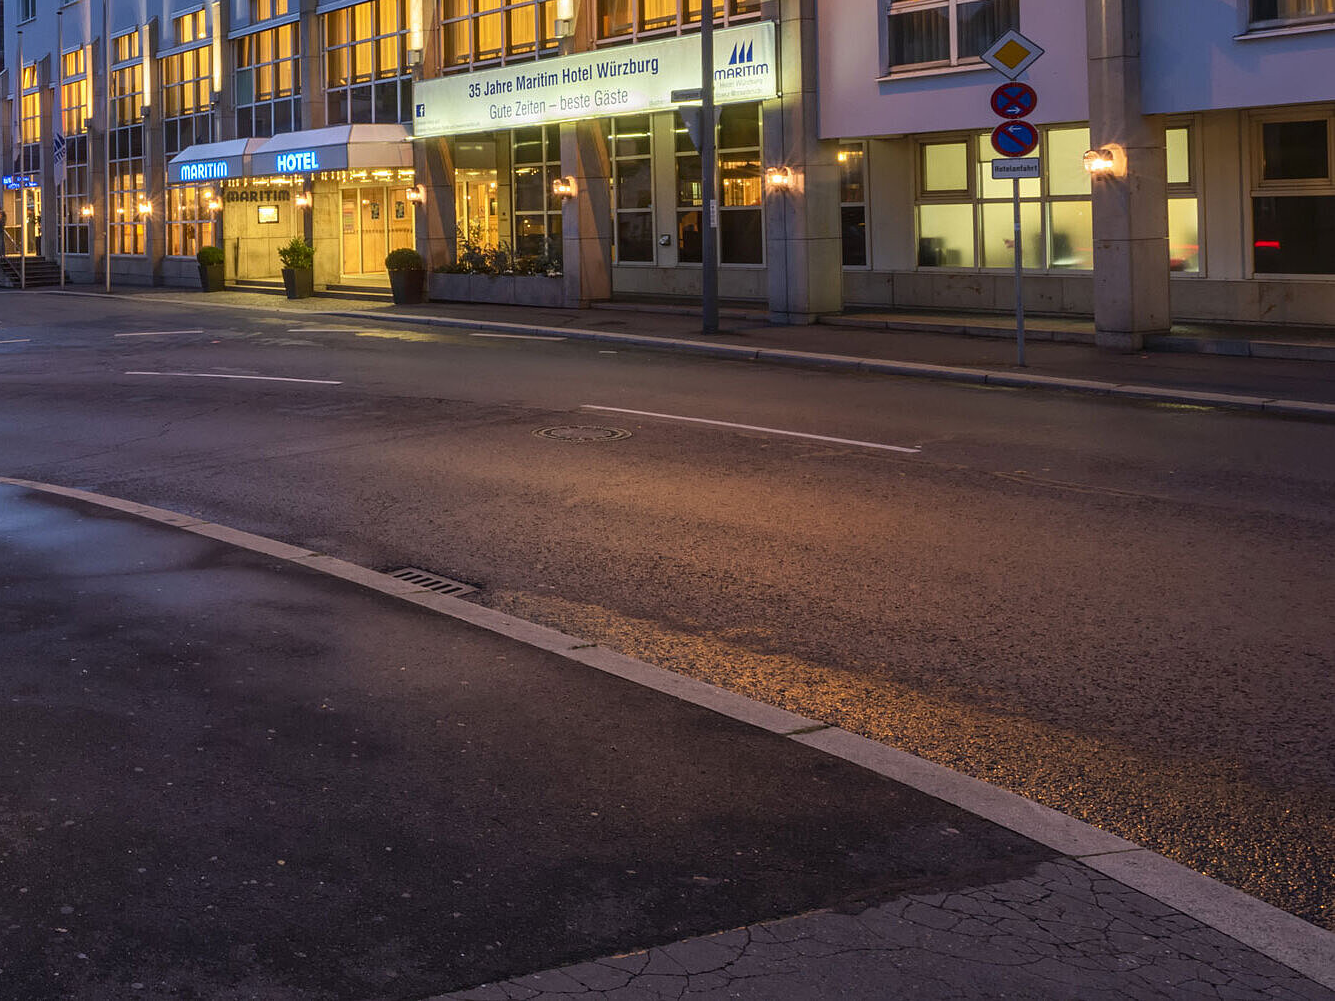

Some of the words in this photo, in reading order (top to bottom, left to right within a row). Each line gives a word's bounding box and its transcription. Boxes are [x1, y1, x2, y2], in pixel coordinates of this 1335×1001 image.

[469, 83, 481, 98] 35
[484, 80, 513, 96] Jahre
[516, 73, 558, 91] Maritim
[562, 65, 593, 84] Hotel
[597, 57, 659, 79] Würzburg
[714, 63, 769, 80] MARITIM
[489, 104, 513, 120] Gute
[515, 100, 546, 117] Zeiten
[560, 95, 590, 111] beste
[594, 88, 629, 107] Gäste
[180, 160, 228, 181] MARITIM
[277, 151, 319, 172] HOTEL
[226, 189, 291, 203] MARITIM
